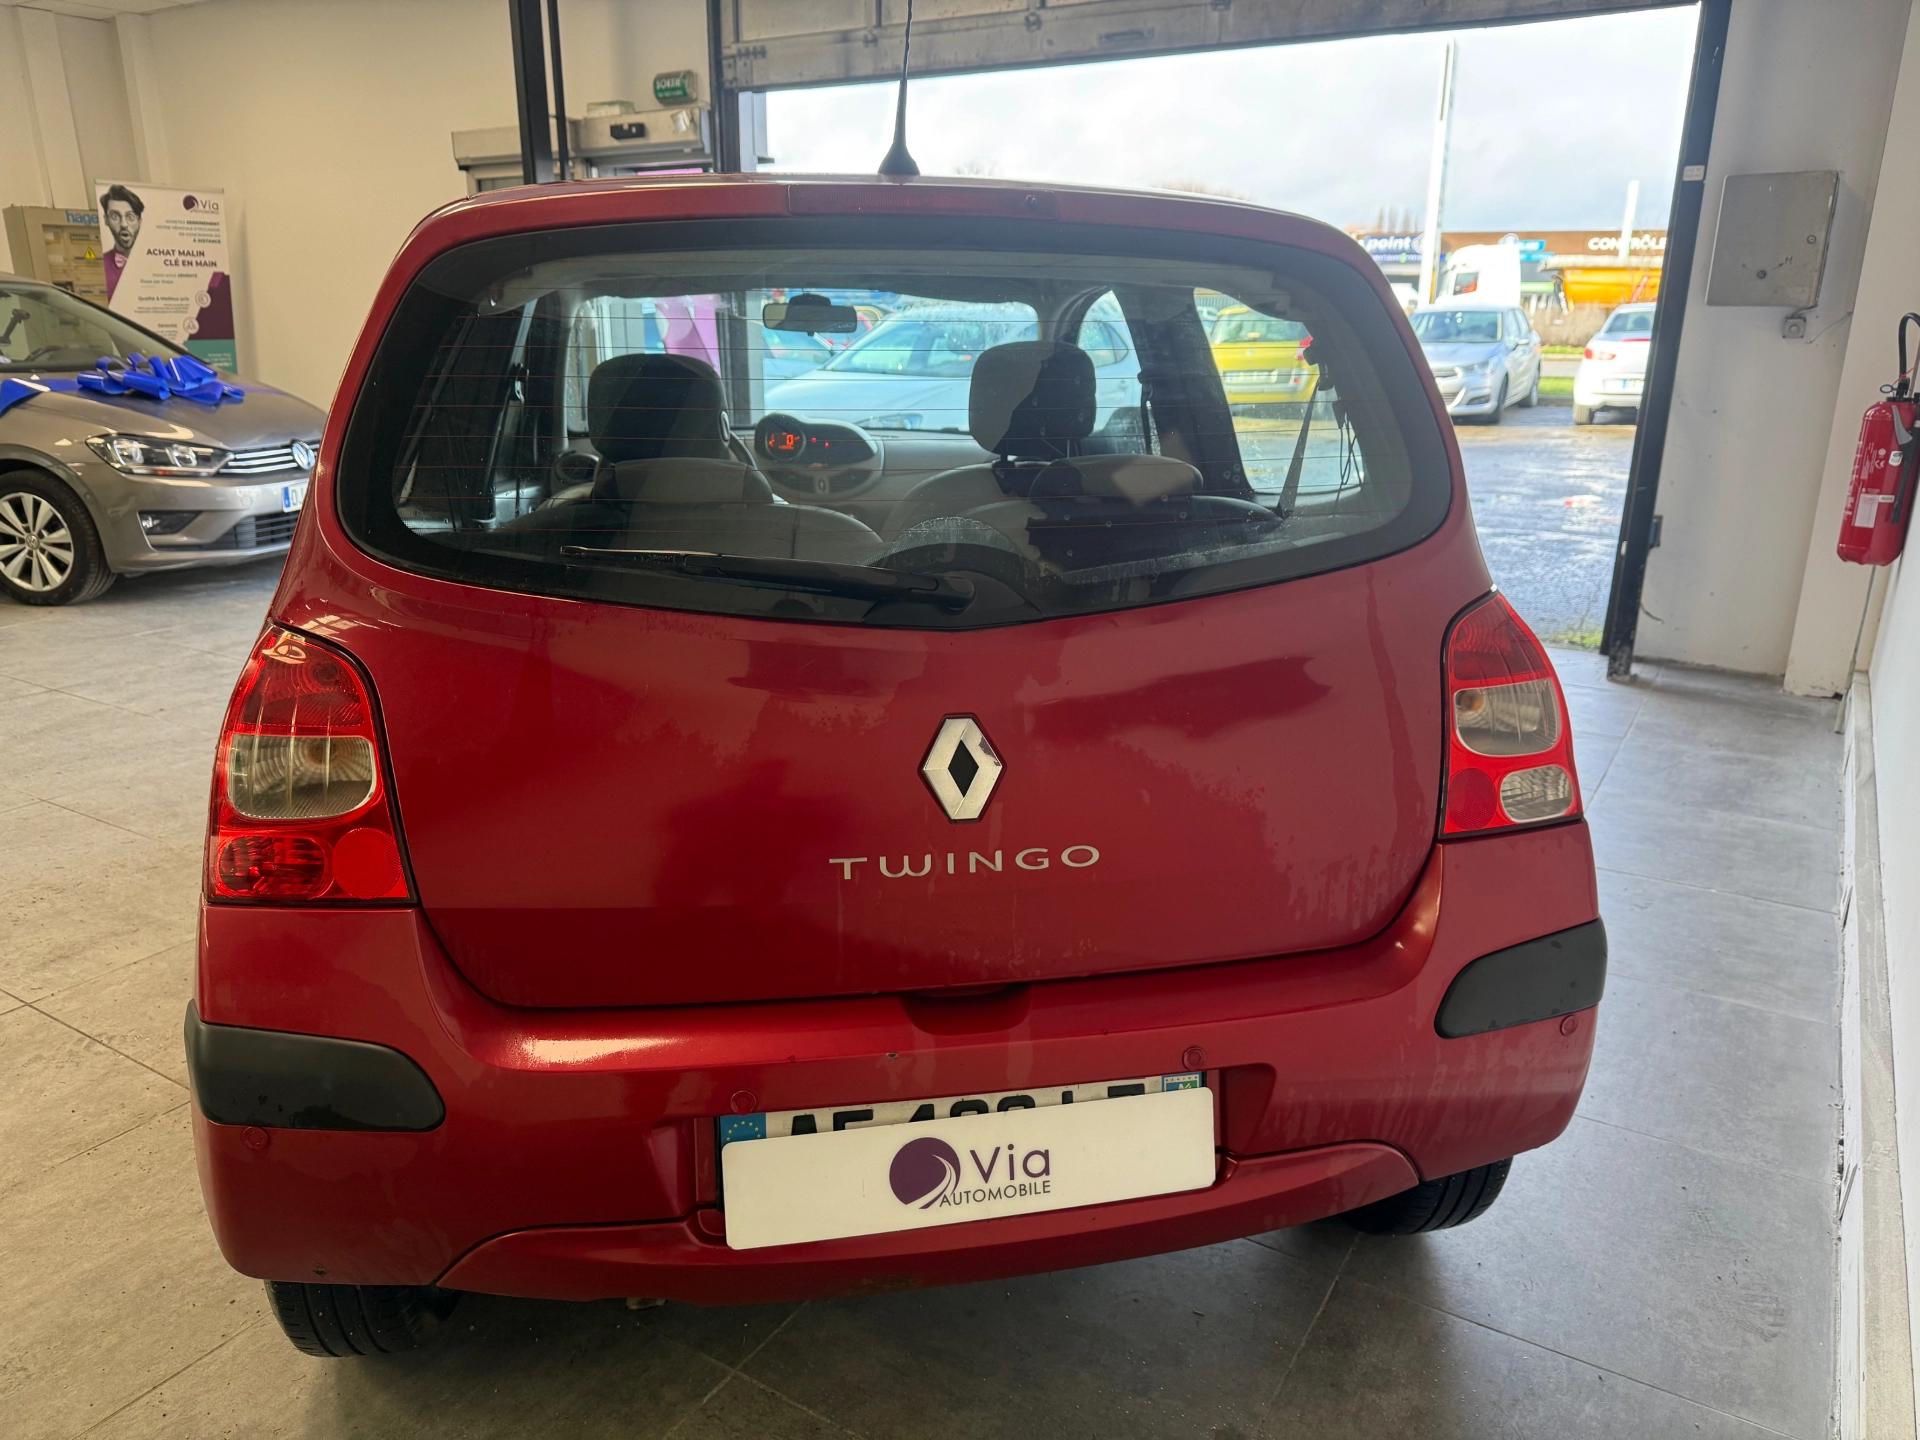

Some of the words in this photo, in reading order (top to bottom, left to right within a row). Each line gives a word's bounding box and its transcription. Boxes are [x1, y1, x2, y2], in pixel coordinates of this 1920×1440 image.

[201, 199, 219, 210] Via
[146, 248, 176, 257] ACHAT
[178, 249, 205, 257] MALIN
[163, 257, 180, 267] CLÉ
[195, 260, 218, 268] MAIN
[829, 845, 1100, 880] TWINGO
[970, 1143, 1051, 1184] Via
[939, 1180, 1051, 1208] AUTOMOBILE
